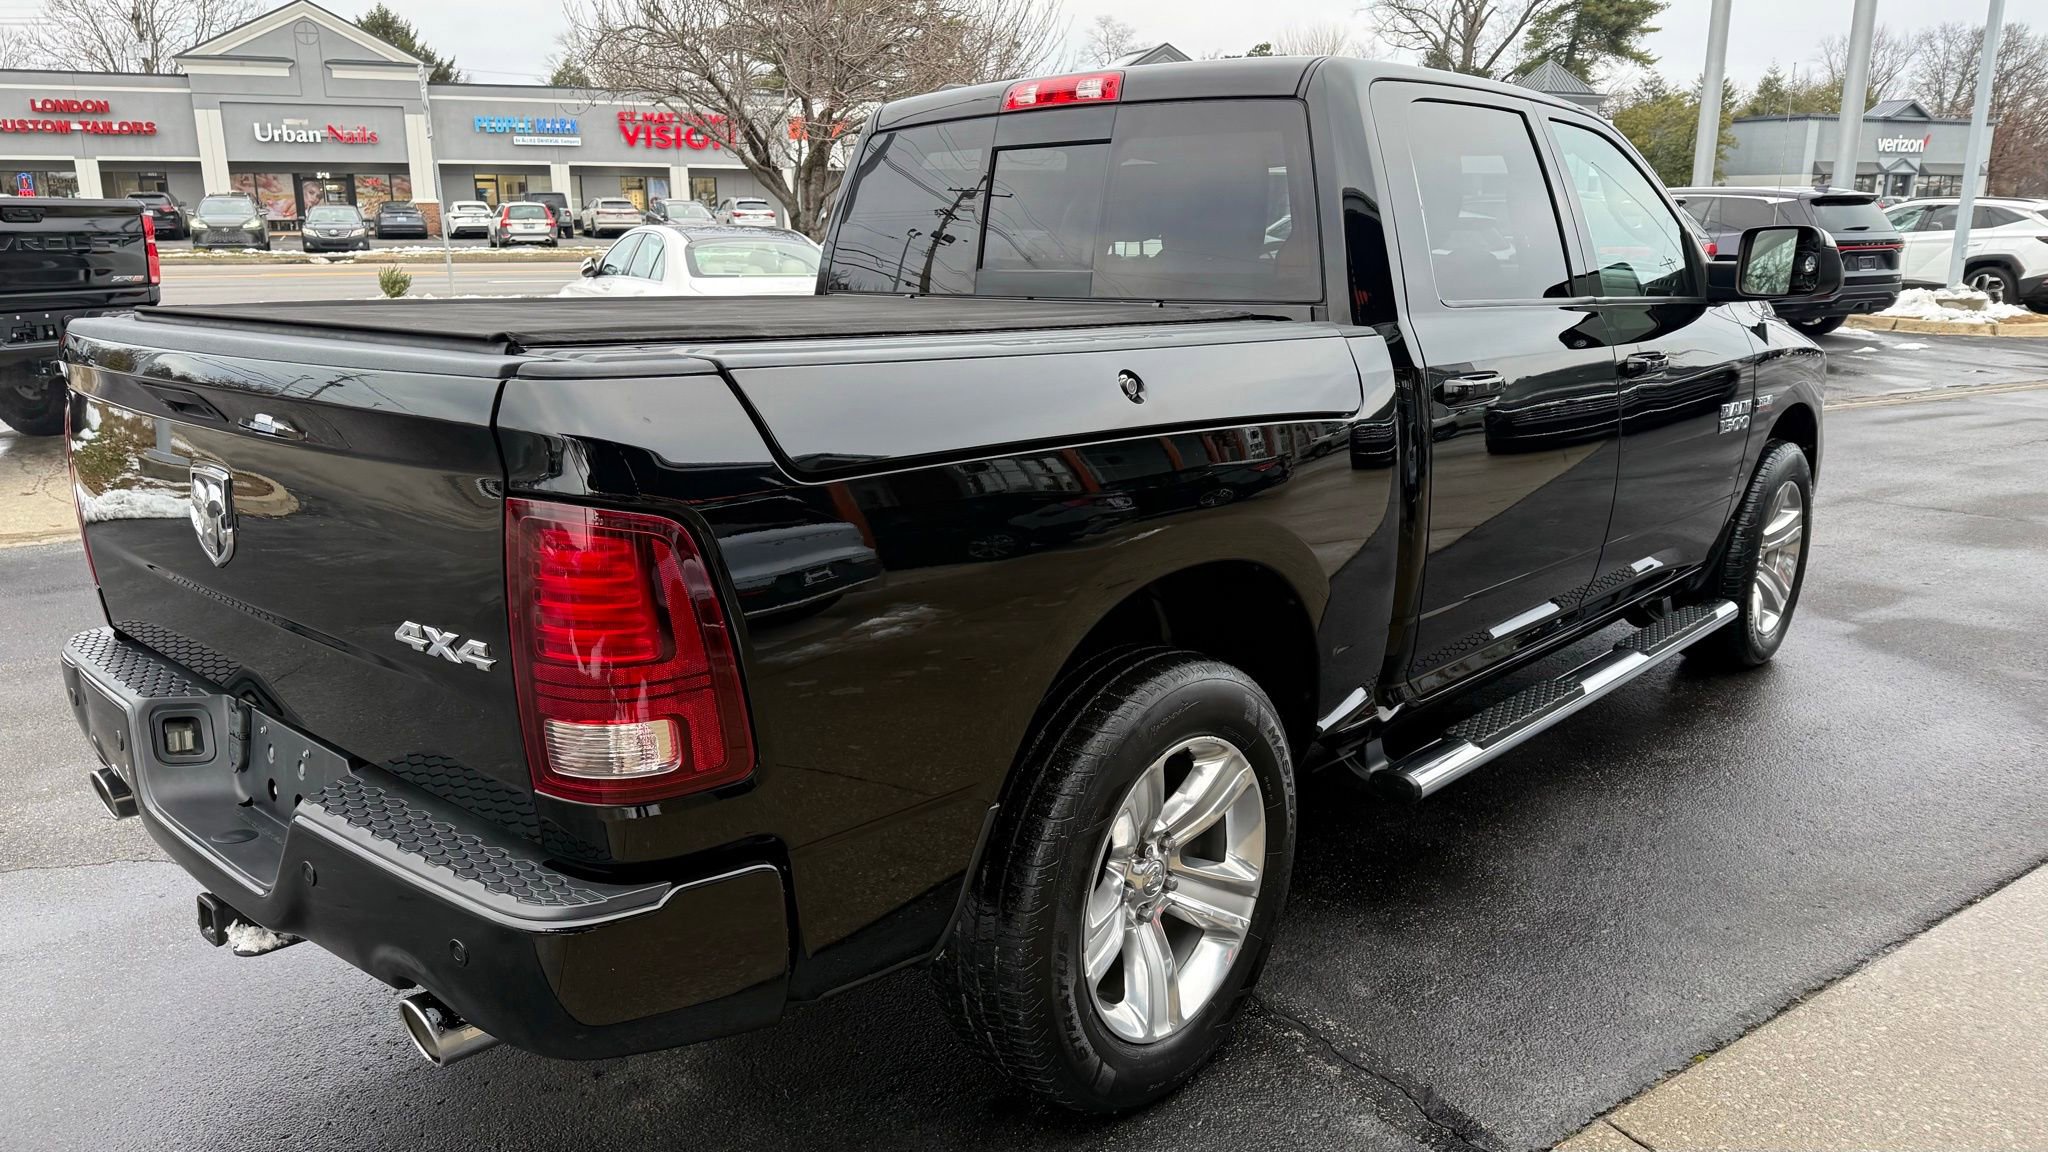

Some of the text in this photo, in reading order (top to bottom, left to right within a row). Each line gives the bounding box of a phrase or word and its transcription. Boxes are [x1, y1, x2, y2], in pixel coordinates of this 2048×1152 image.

[30, 98, 111, 113] LONDON
[0, 118, 158, 136] USTOM TAILORS
[253, 122, 379, 145] Urban Nails
[474, 115, 578, 134] PEOPLE MARK
[1877, 134, 1924, 153] verizon
[1719, 399, 1753, 420] RAM
[1719, 414, 1751, 435] 1500
